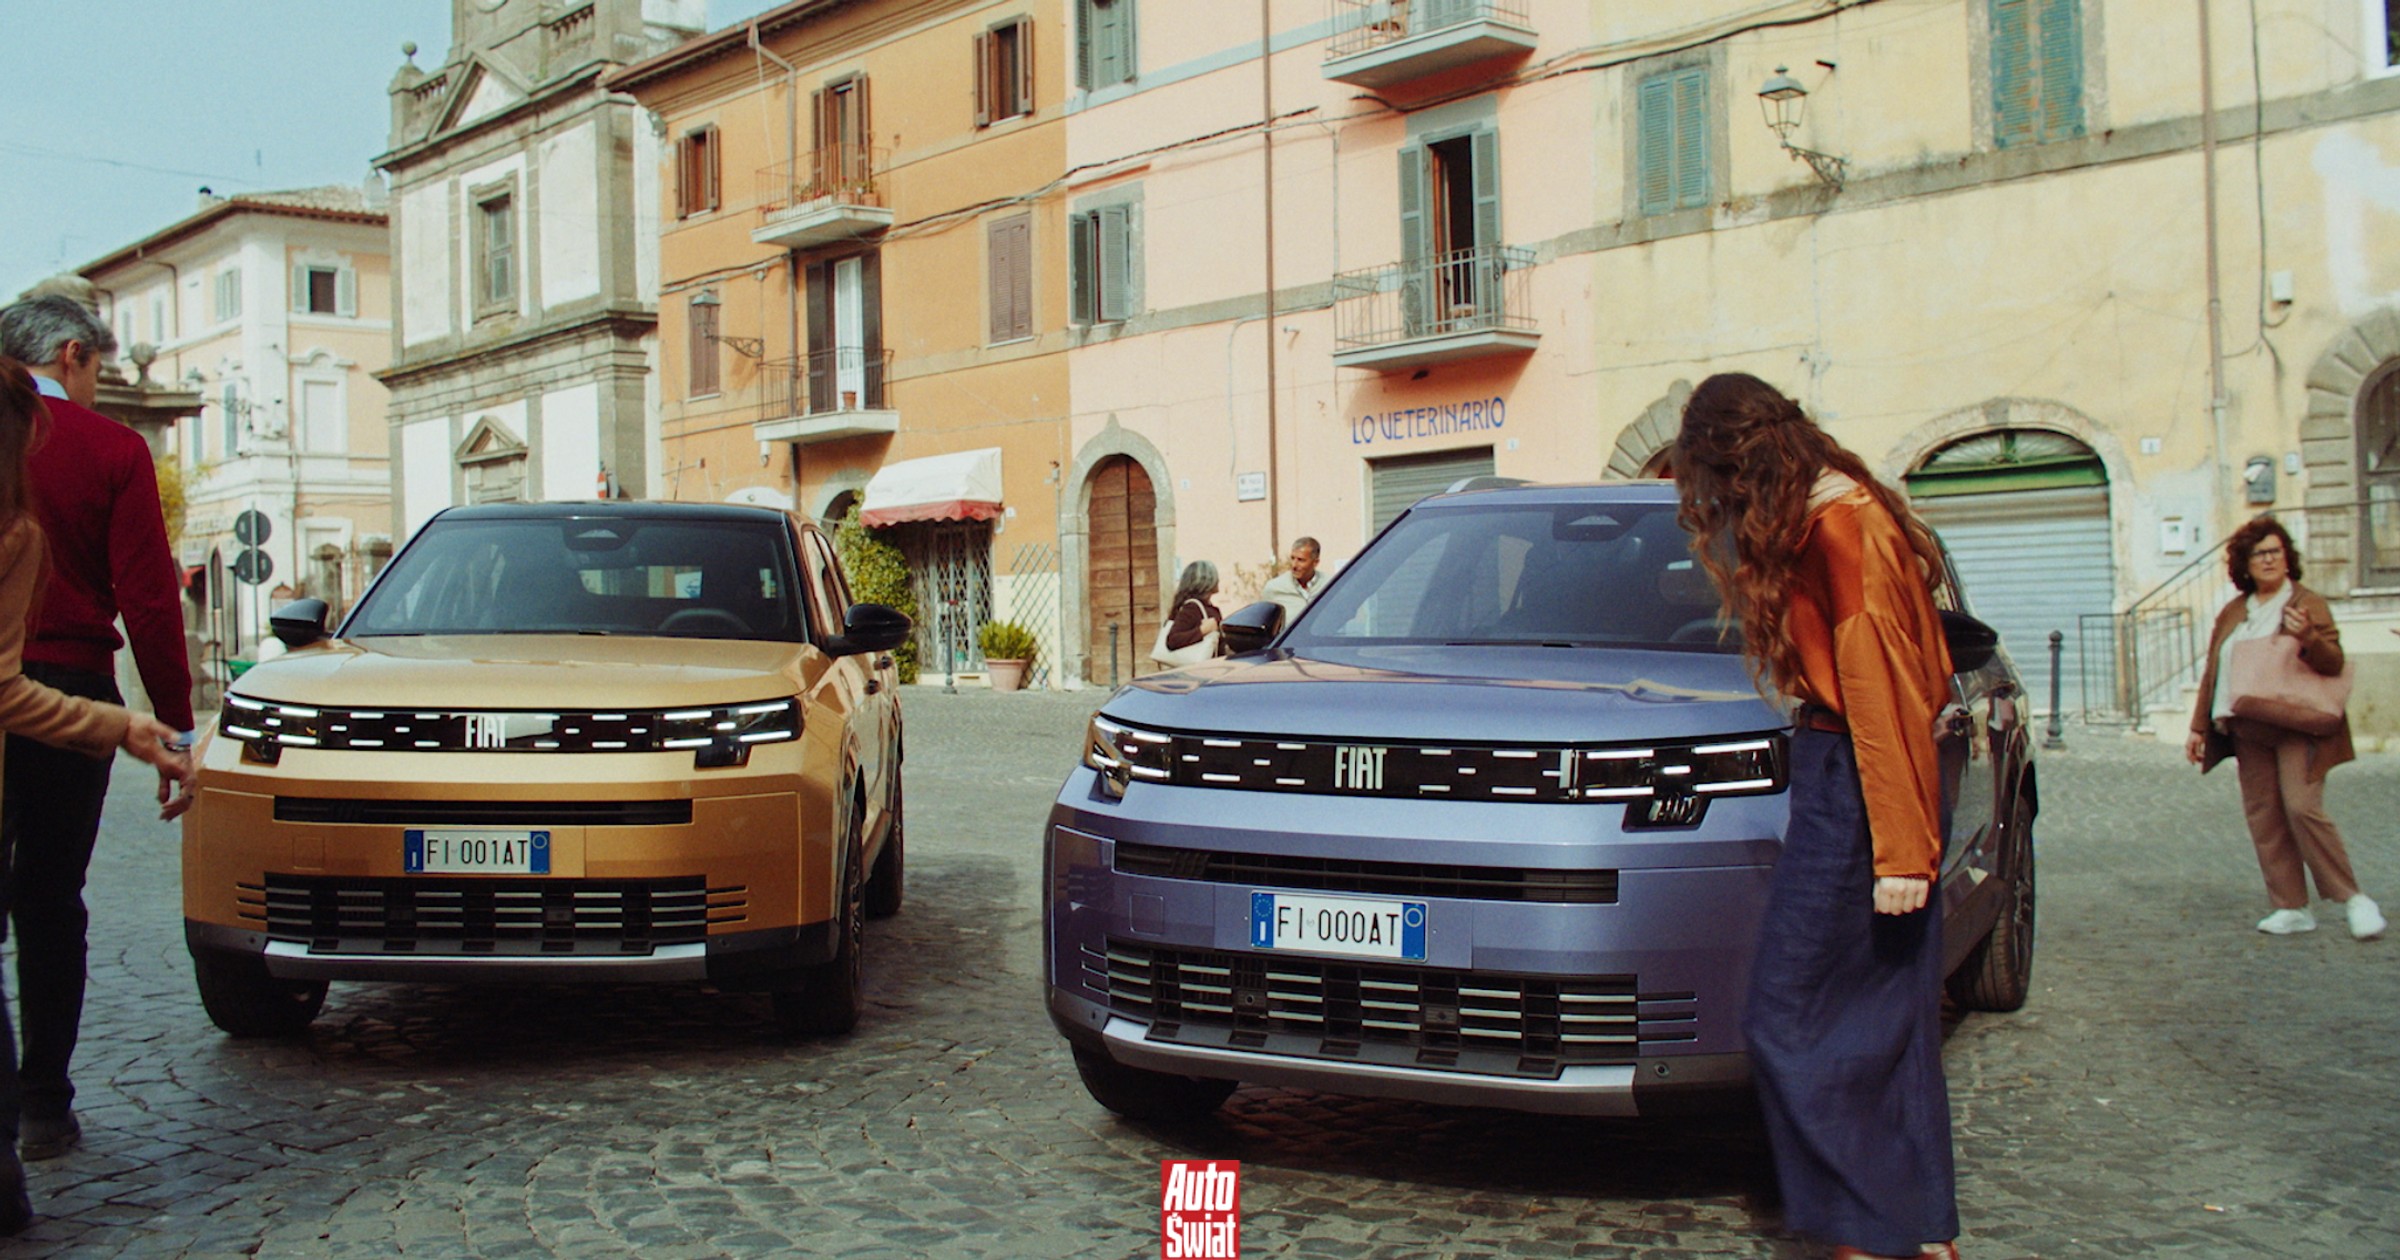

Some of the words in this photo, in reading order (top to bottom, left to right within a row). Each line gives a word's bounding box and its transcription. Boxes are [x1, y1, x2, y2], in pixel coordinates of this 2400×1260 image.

[1352, 415, 1375, 444] LO
[465, 715, 508, 748] FIAT
[1334, 746, 1387, 790] FIAT
